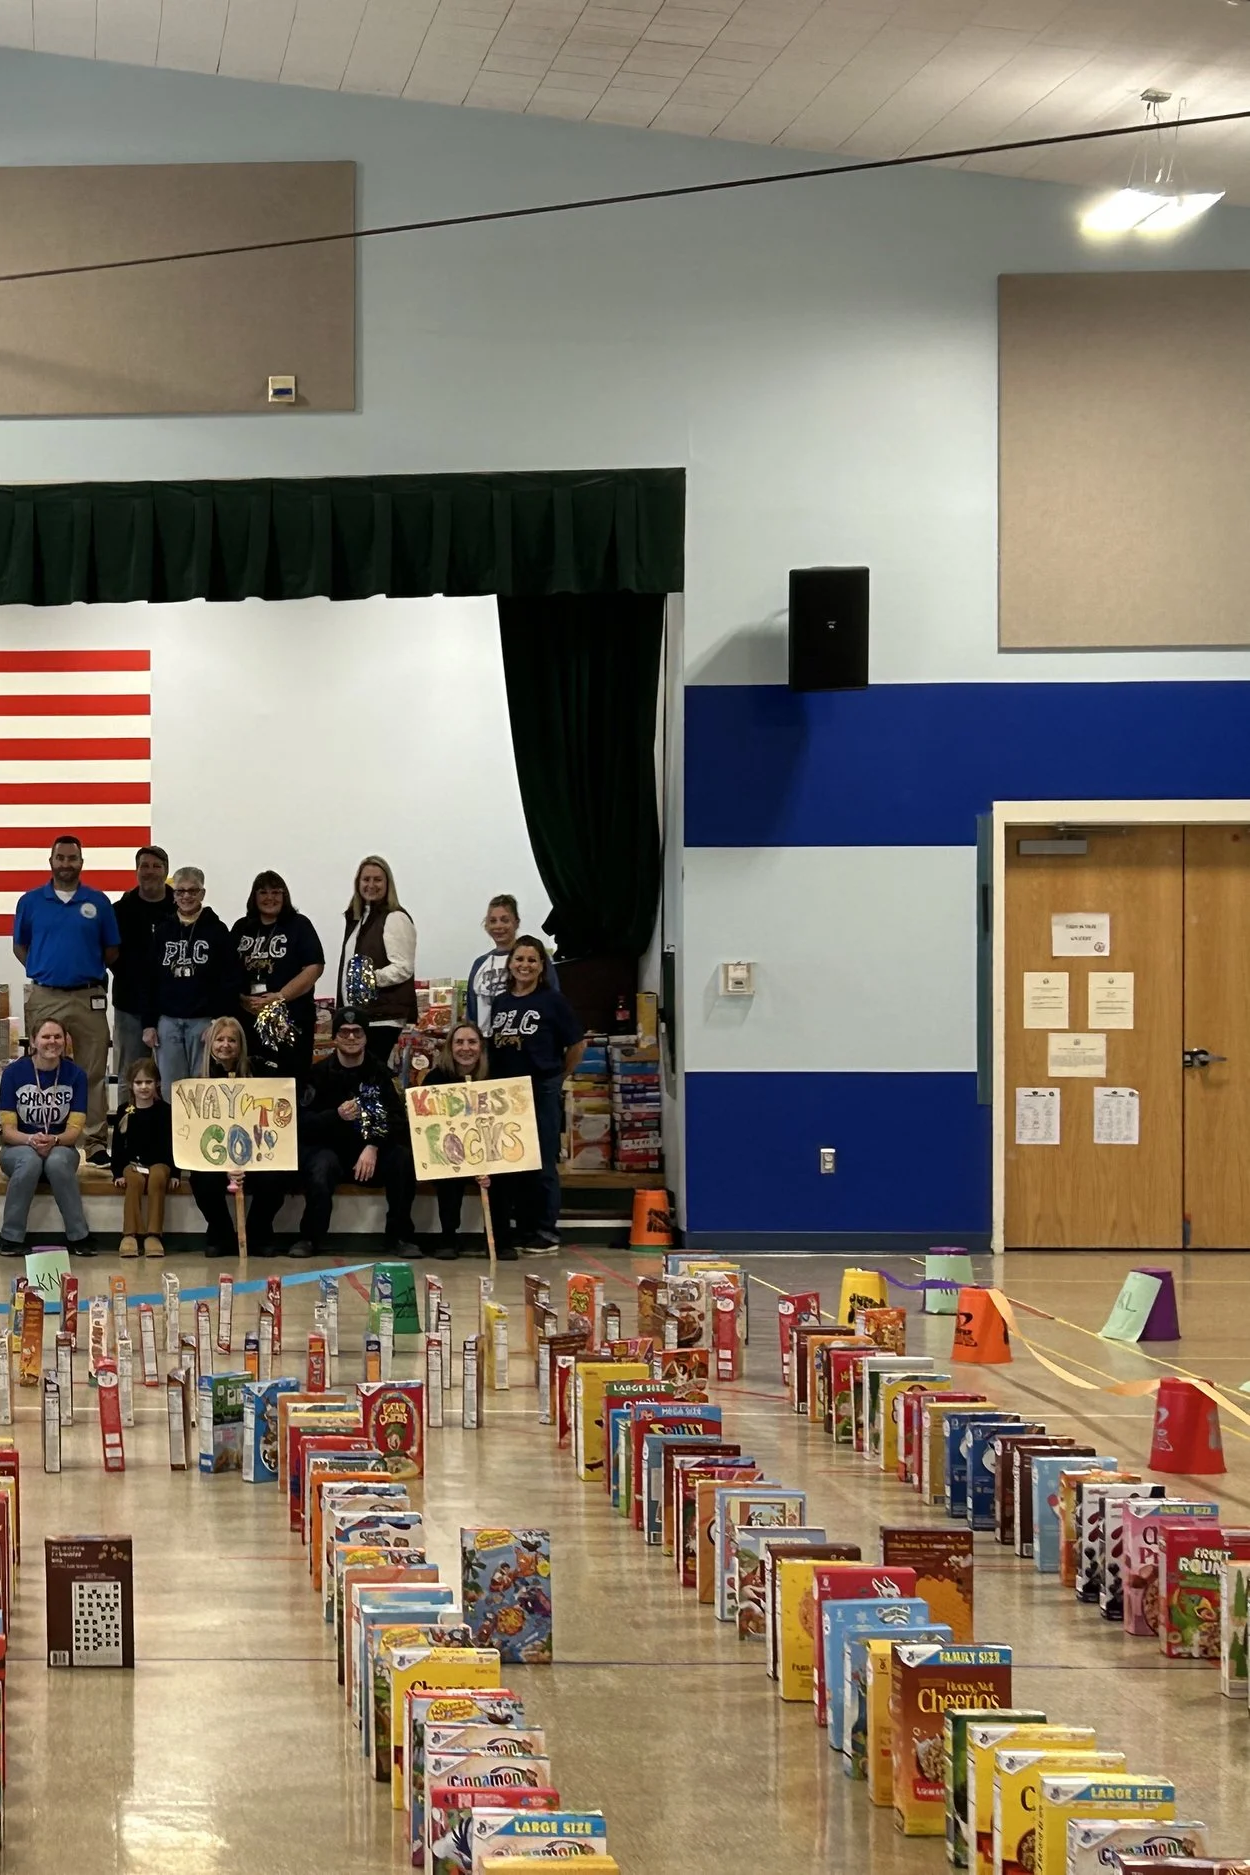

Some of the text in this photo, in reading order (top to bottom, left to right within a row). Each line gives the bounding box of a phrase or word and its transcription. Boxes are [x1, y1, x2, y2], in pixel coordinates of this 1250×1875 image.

[162, 940, 210, 966] PLC
[237, 934, 287, 960] PLC
[490, 1009, 540, 1038] PLC
[19, 1085, 71, 1106] CHOOSE
[175, 1082, 293, 1128] WAY TO
[410, 1084, 531, 1118] KINDNESS
[25, 1107, 61, 1124] KIND
[424, 1120, 525, 1166] ROCKS
[1194, 1547, 1231, 1561] FRUIT
[939, 1652, 977, 1665] FAMILY
[917, 1687, 1000, 1713] Cheerios
[447, 1771, 524, 1787] Cinnamon
[1090, 1787, 1163, 1800] LARGE SIZE
[514, 1821, 592, 1835] LARGE SIZE
